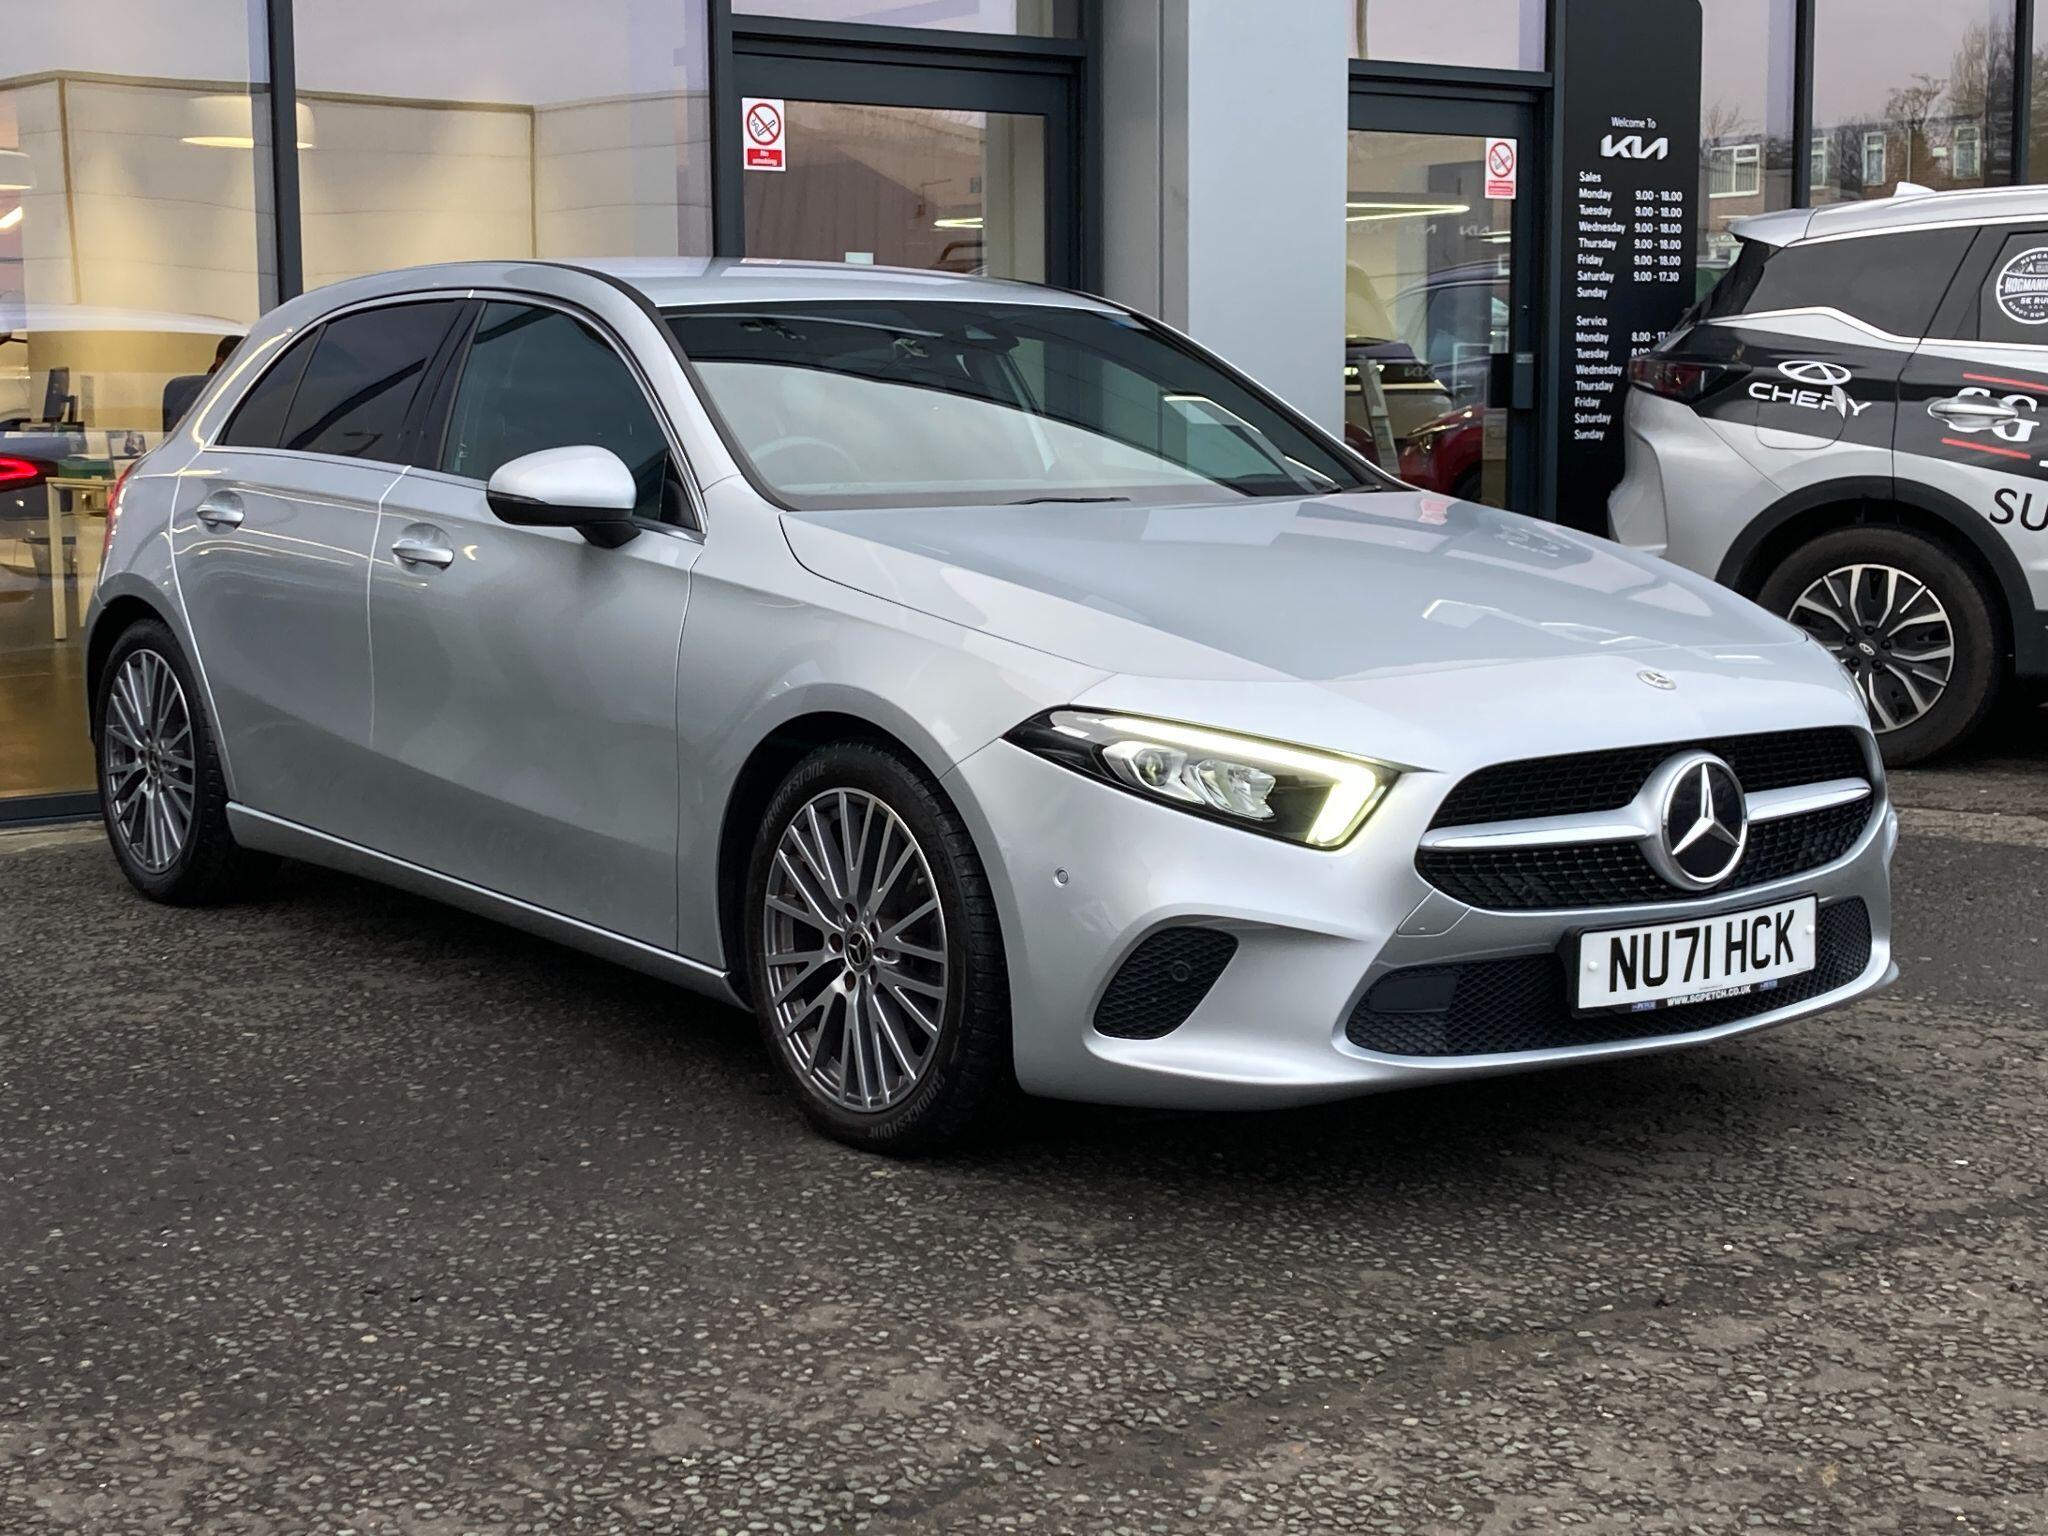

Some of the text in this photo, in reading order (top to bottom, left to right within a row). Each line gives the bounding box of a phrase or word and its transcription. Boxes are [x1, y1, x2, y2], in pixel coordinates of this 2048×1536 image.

[1611, 116, 1657, 129] Welcome To
[1600, 134, 1669, 160] KIA
[1579, 170, 1602, 182] Sales
[1579, 188, 1612, 202] Monday
[1635, 190, 1654, 200] 9.00
[1660, 191, 1683, 202] 18.00
[1579, 204, 1612, 218] Tuesday
[1635, 206, 1654, 217] 9.00
[1660, 207, 1682, 218] 18.00
[1578, 221, 1626, 235] Wednesday
[1634, 222, 1653, 233] 9.00
[1659, 223, 1682, 234] 18.00
[1578, 237, 1617, 251] Thursday
[1634, 238, 1653, 249] 9.00
[1659, 239, 1682, 250] 18.00
[1577, 254, 1604, 267] Friday
[1633, 255, 1652, 265] 9.00
[1659, 255, 1681, 266] 18.00
[1577, 270, 1615, 284] Saturday
[1633, 271, 1652, 282] 9.00
[1659, 271, 1680, 282] 17.30
[1577, 286, 1608, 300] Sunday
[1576, 315, 1608, 326] Service
[1575, 332, 1609, 345] Monday
[1631, 332, 1651, 342] 8.00
[1576, 348, 1609, 361] Tuesday
[1575, 364, 1623, 377] Wednesday
[1575, 380, 1614, 393] Thursday
[1574, 397, 1601, 409] Friday
[1574, 412, 1612, 425] Saturday
[1574, 429, 1605, 441] Sunday
[1609, 909, 1795, 992] NU71 HCK
